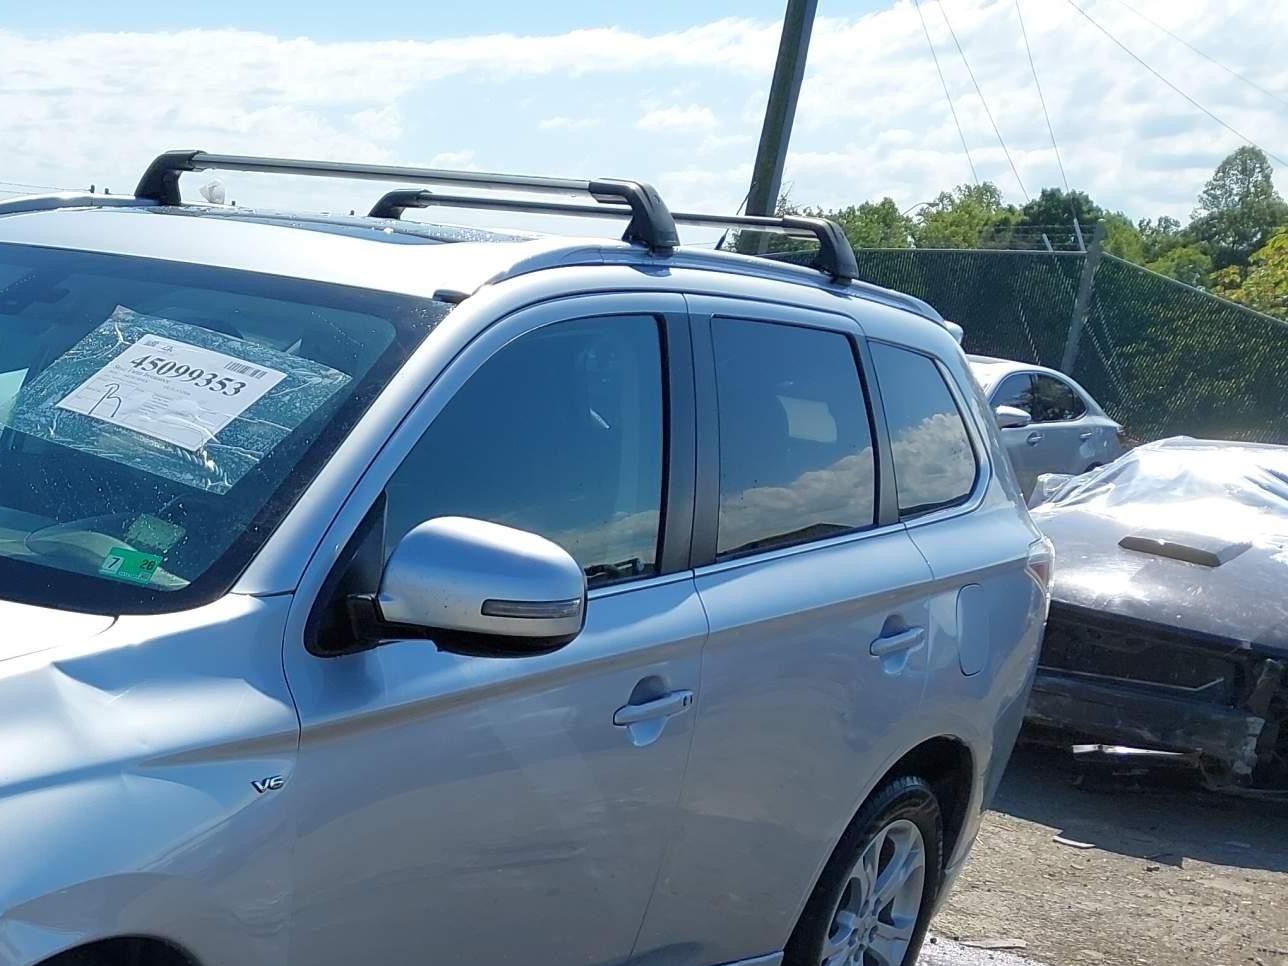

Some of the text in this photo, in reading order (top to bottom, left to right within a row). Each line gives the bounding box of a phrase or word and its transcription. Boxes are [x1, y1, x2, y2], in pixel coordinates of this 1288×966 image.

[130, 354, 247, 397] 45099353
[107, 556, 121, 569] 7
[251, 774, 284, 794] V6
